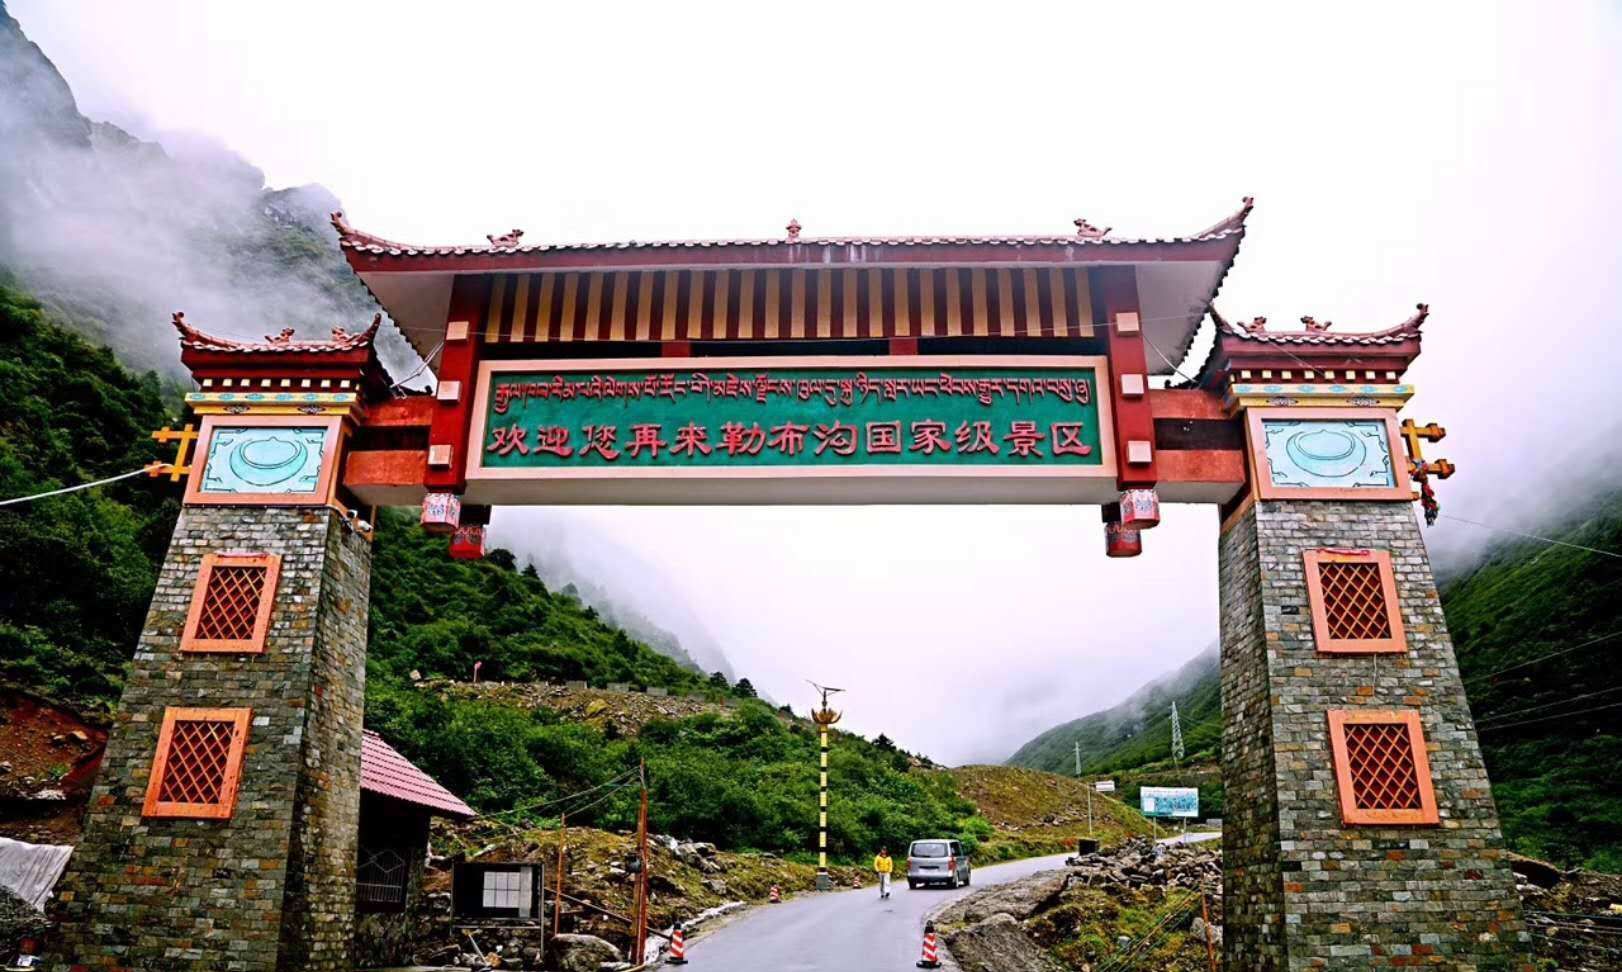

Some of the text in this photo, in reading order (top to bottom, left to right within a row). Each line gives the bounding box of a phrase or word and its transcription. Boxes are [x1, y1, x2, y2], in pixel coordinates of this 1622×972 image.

[486, 419, 1092, 460] 欢迎您再来勒布沟国家级景区
